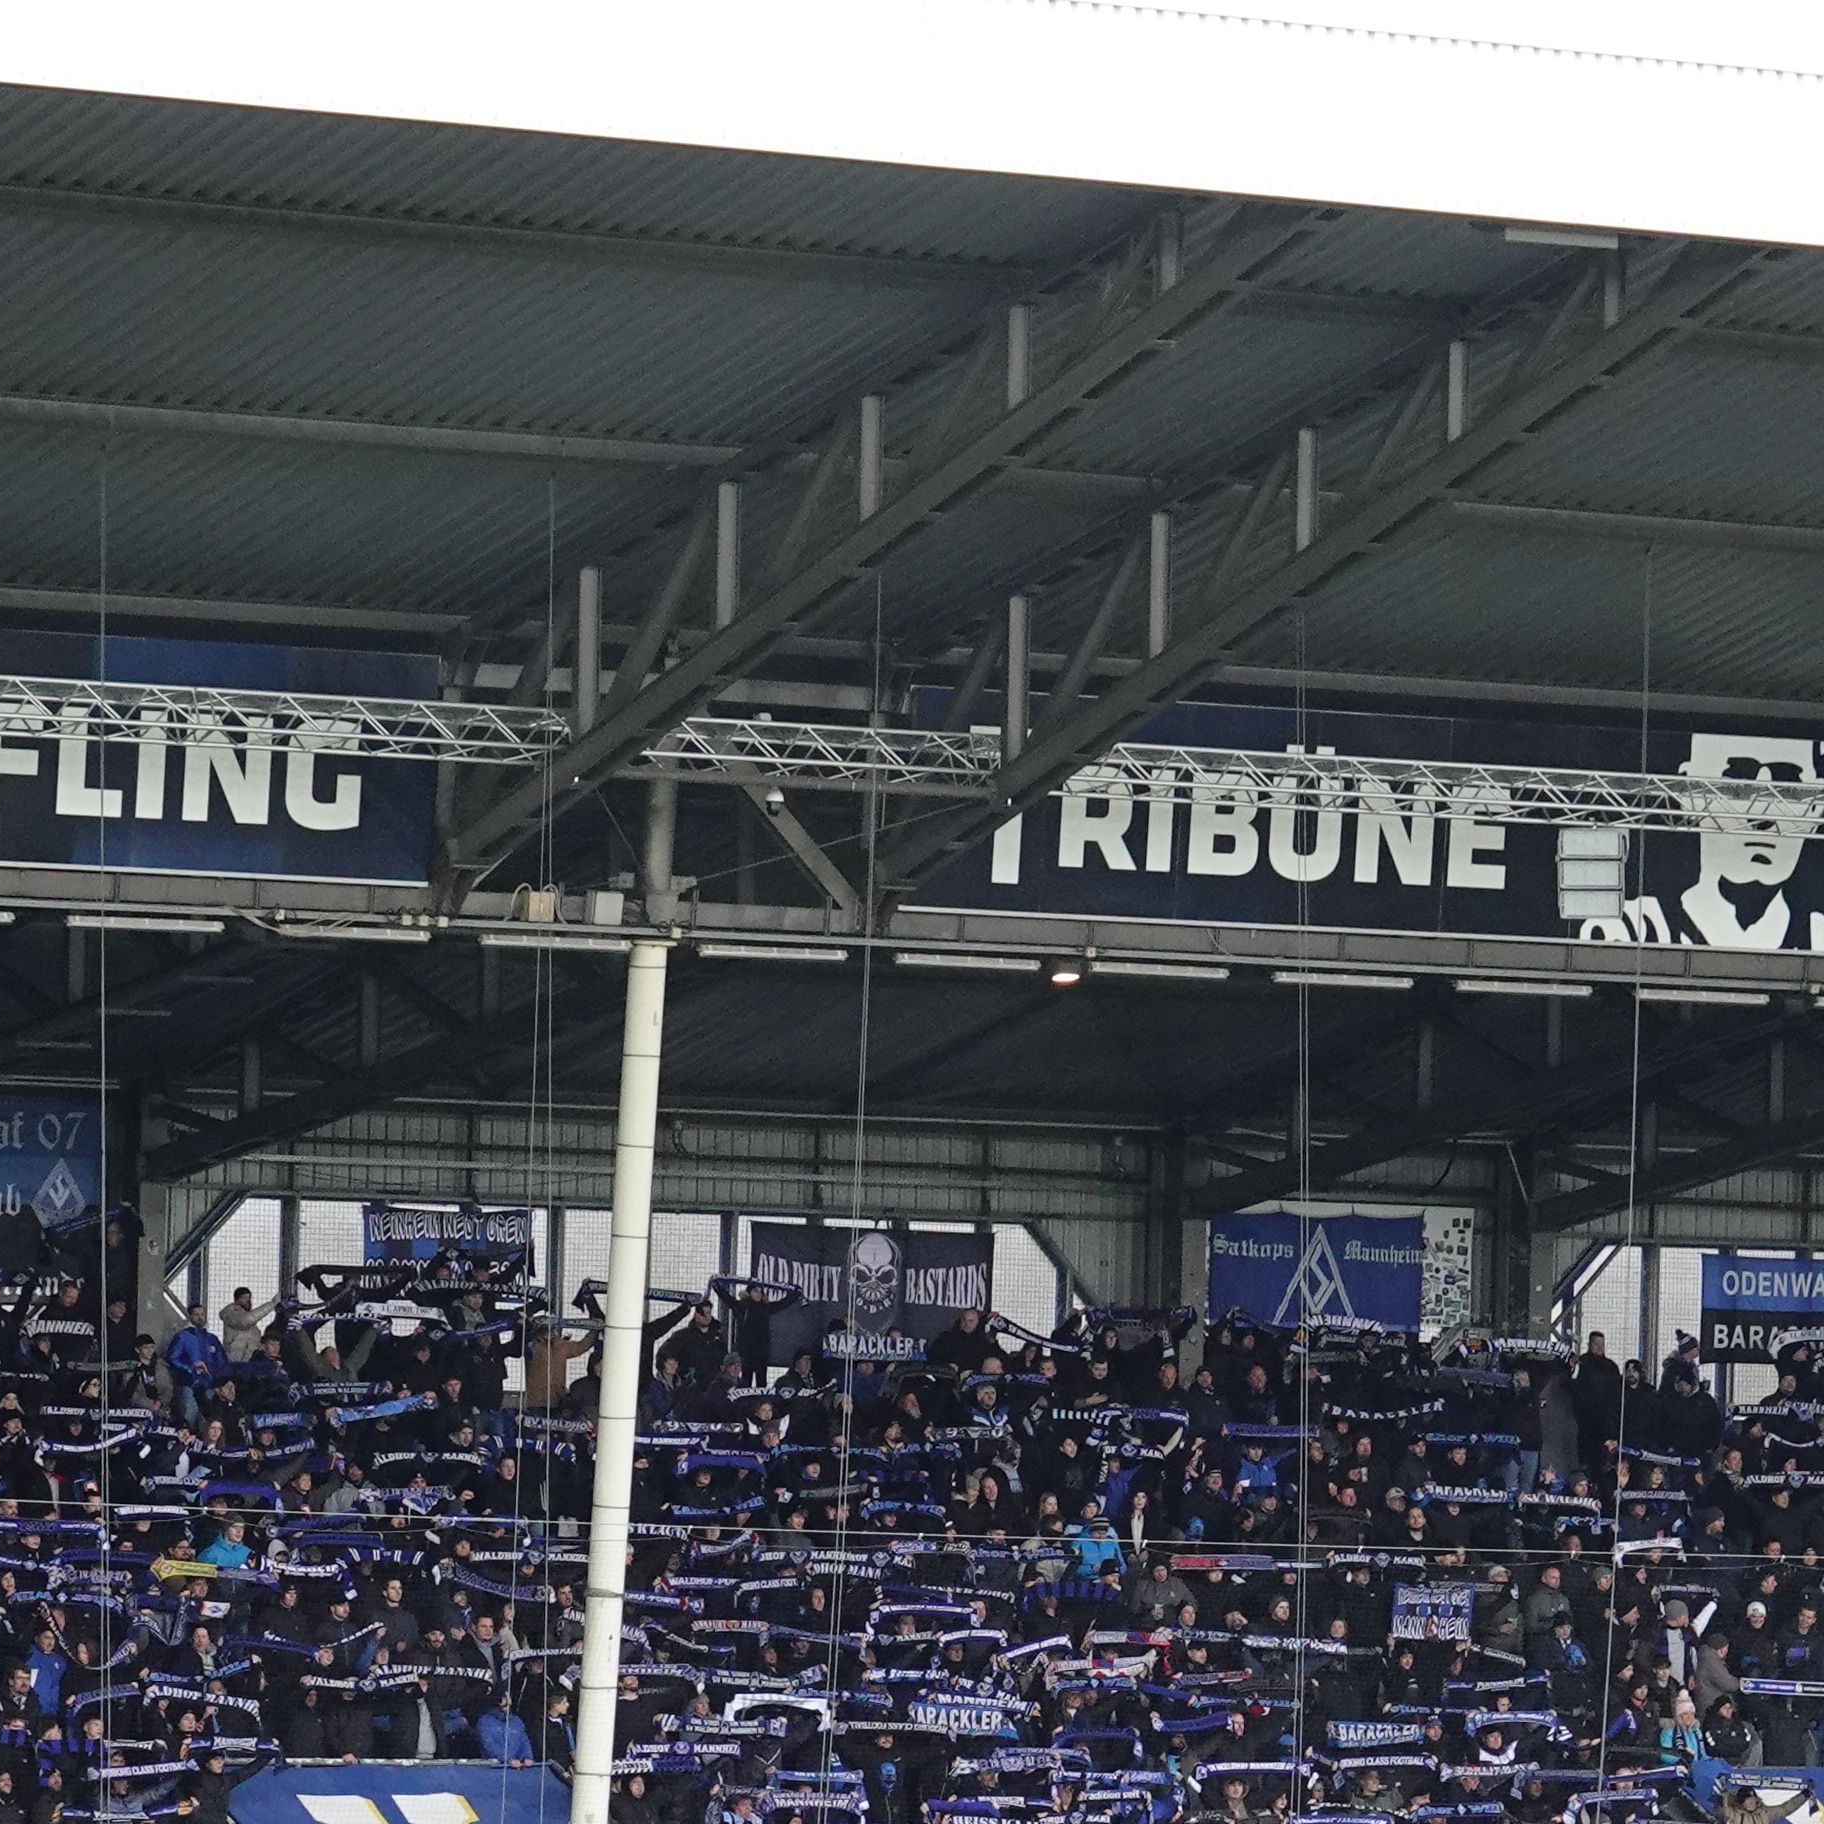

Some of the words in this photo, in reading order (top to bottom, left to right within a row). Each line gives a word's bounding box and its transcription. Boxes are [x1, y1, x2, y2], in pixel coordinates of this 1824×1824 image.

[38, 1112, 86, 1150] 07
[793, 1262, 842, 1302] DIRTY
[905, 1255, 987, 1310] BASTARDS
